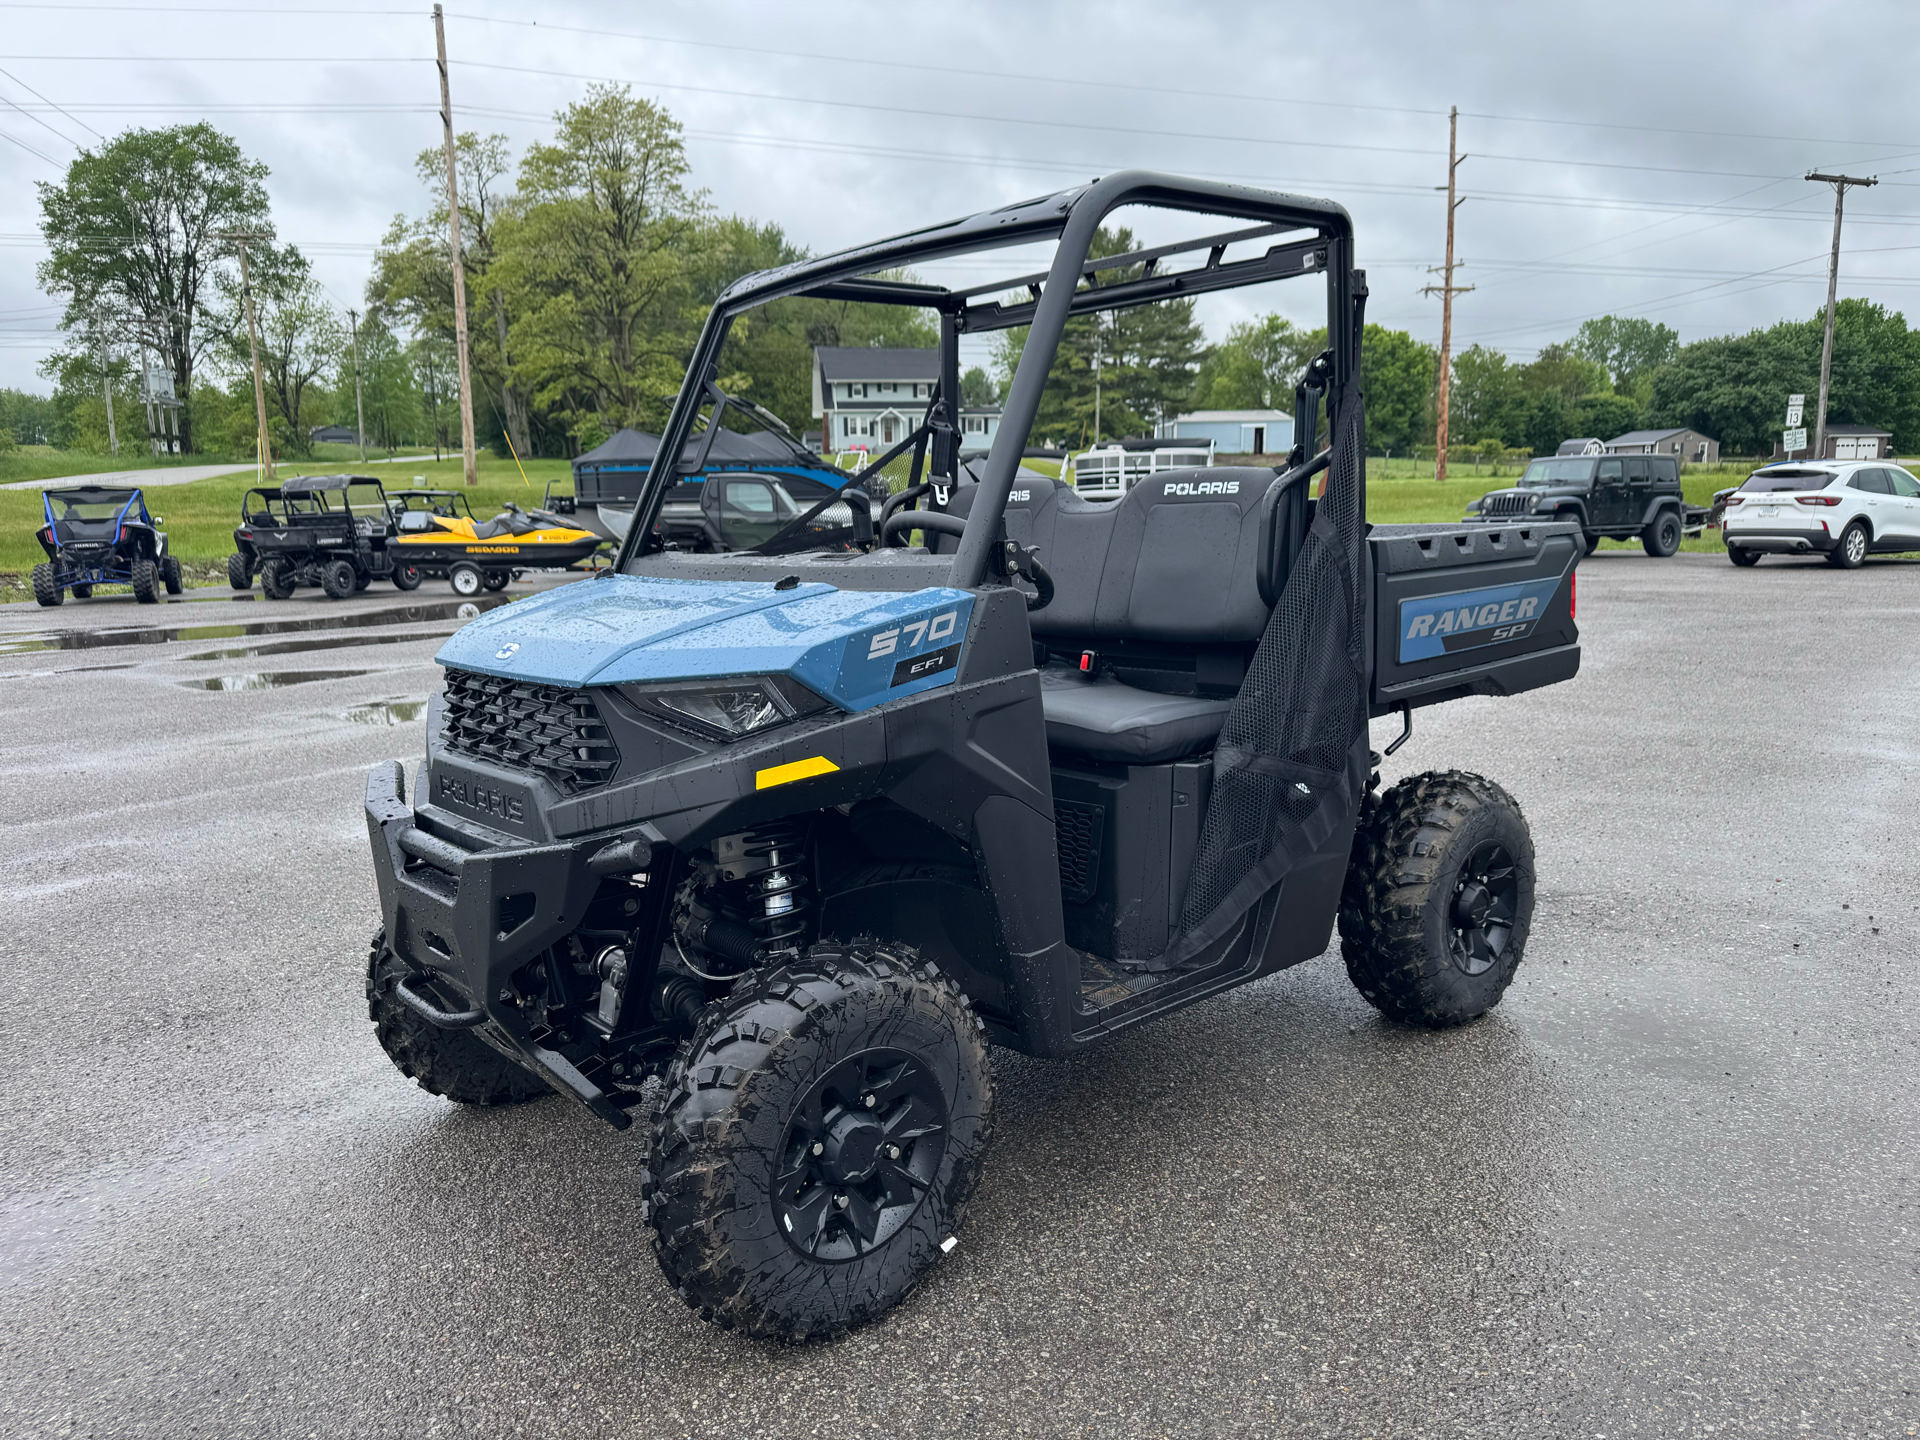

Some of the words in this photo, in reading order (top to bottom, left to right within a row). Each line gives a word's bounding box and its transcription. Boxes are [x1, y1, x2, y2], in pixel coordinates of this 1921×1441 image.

[1789, 412, 1799, 424] 13
[1163, 481, 1240, 496] POLARIS
[1406, 597, 1539, 640] RANGER
[867, 611, 958, 660] 570
[1491, 623, 1528, 641] SP
[910, 656, 944, 674] EFI
[440, 774, 524, 824] POLARIS
